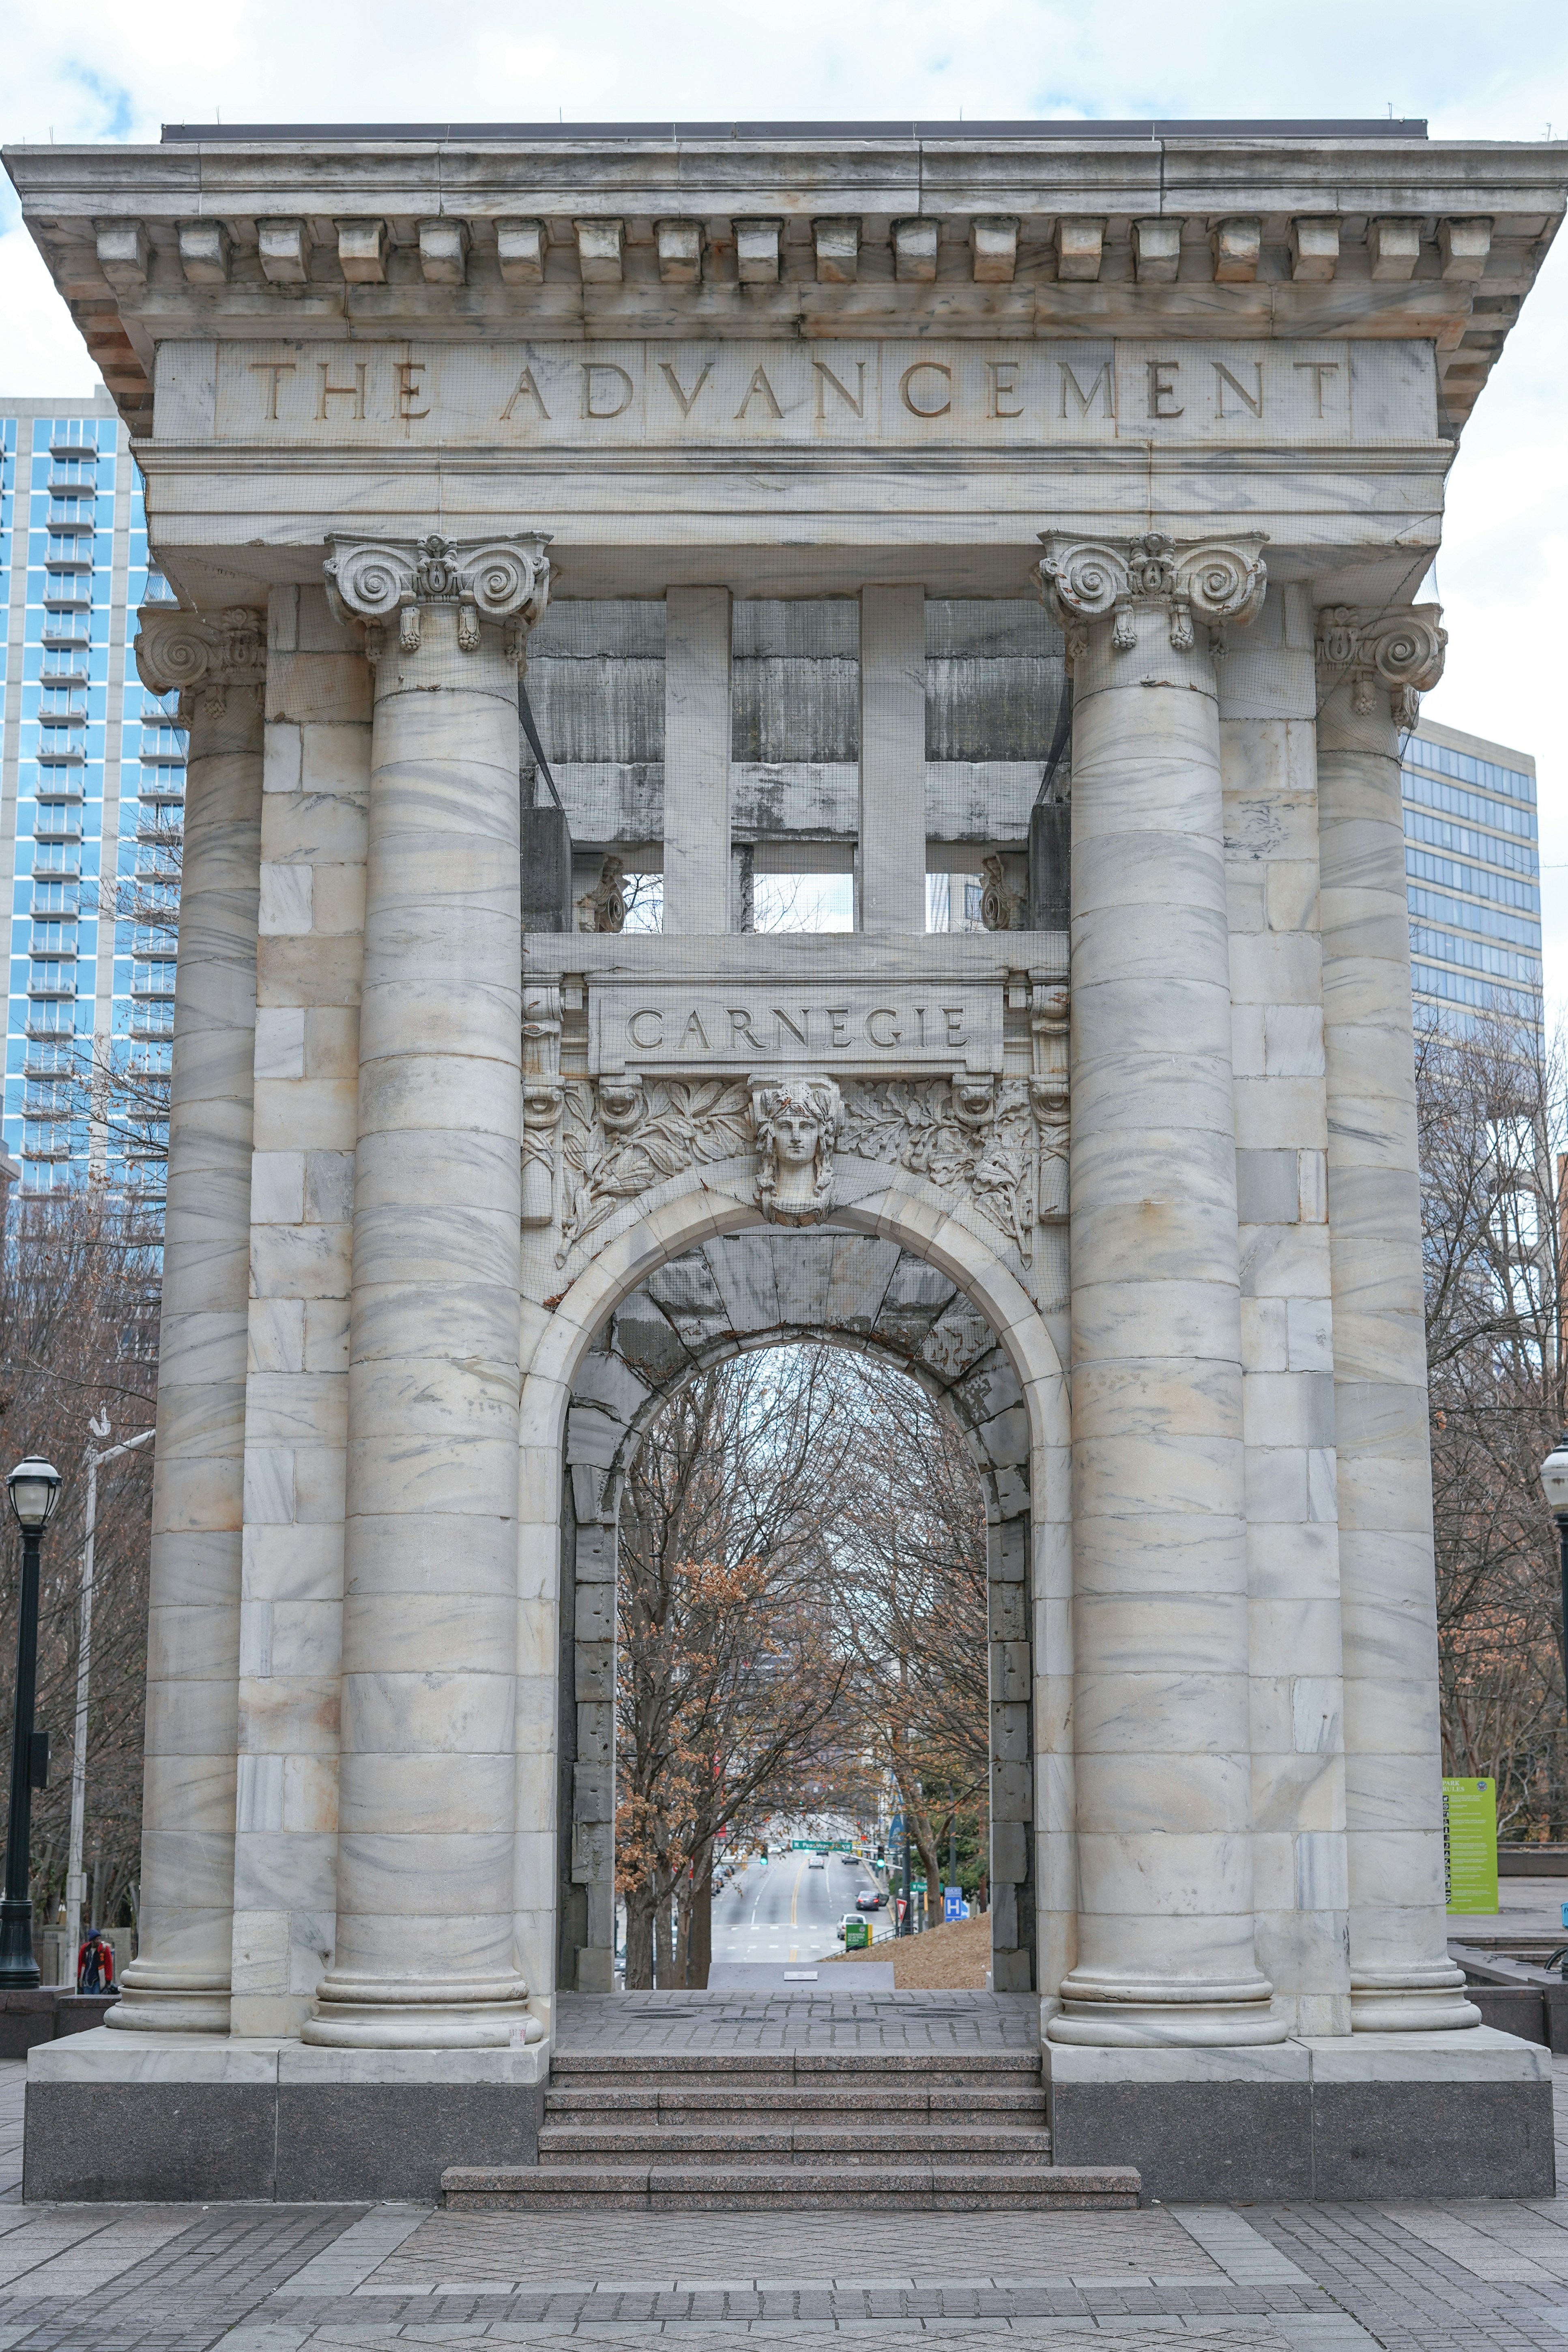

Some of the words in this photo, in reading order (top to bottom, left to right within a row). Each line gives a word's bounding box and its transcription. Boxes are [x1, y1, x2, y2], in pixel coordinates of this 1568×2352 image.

[250, 363, 431, 420] THE
[500, 361, 1339, 420] ADVANCEMENT
[625, 1006, 972, 1052] CARNEGIE
[947, 1899, 960, 1914] H
